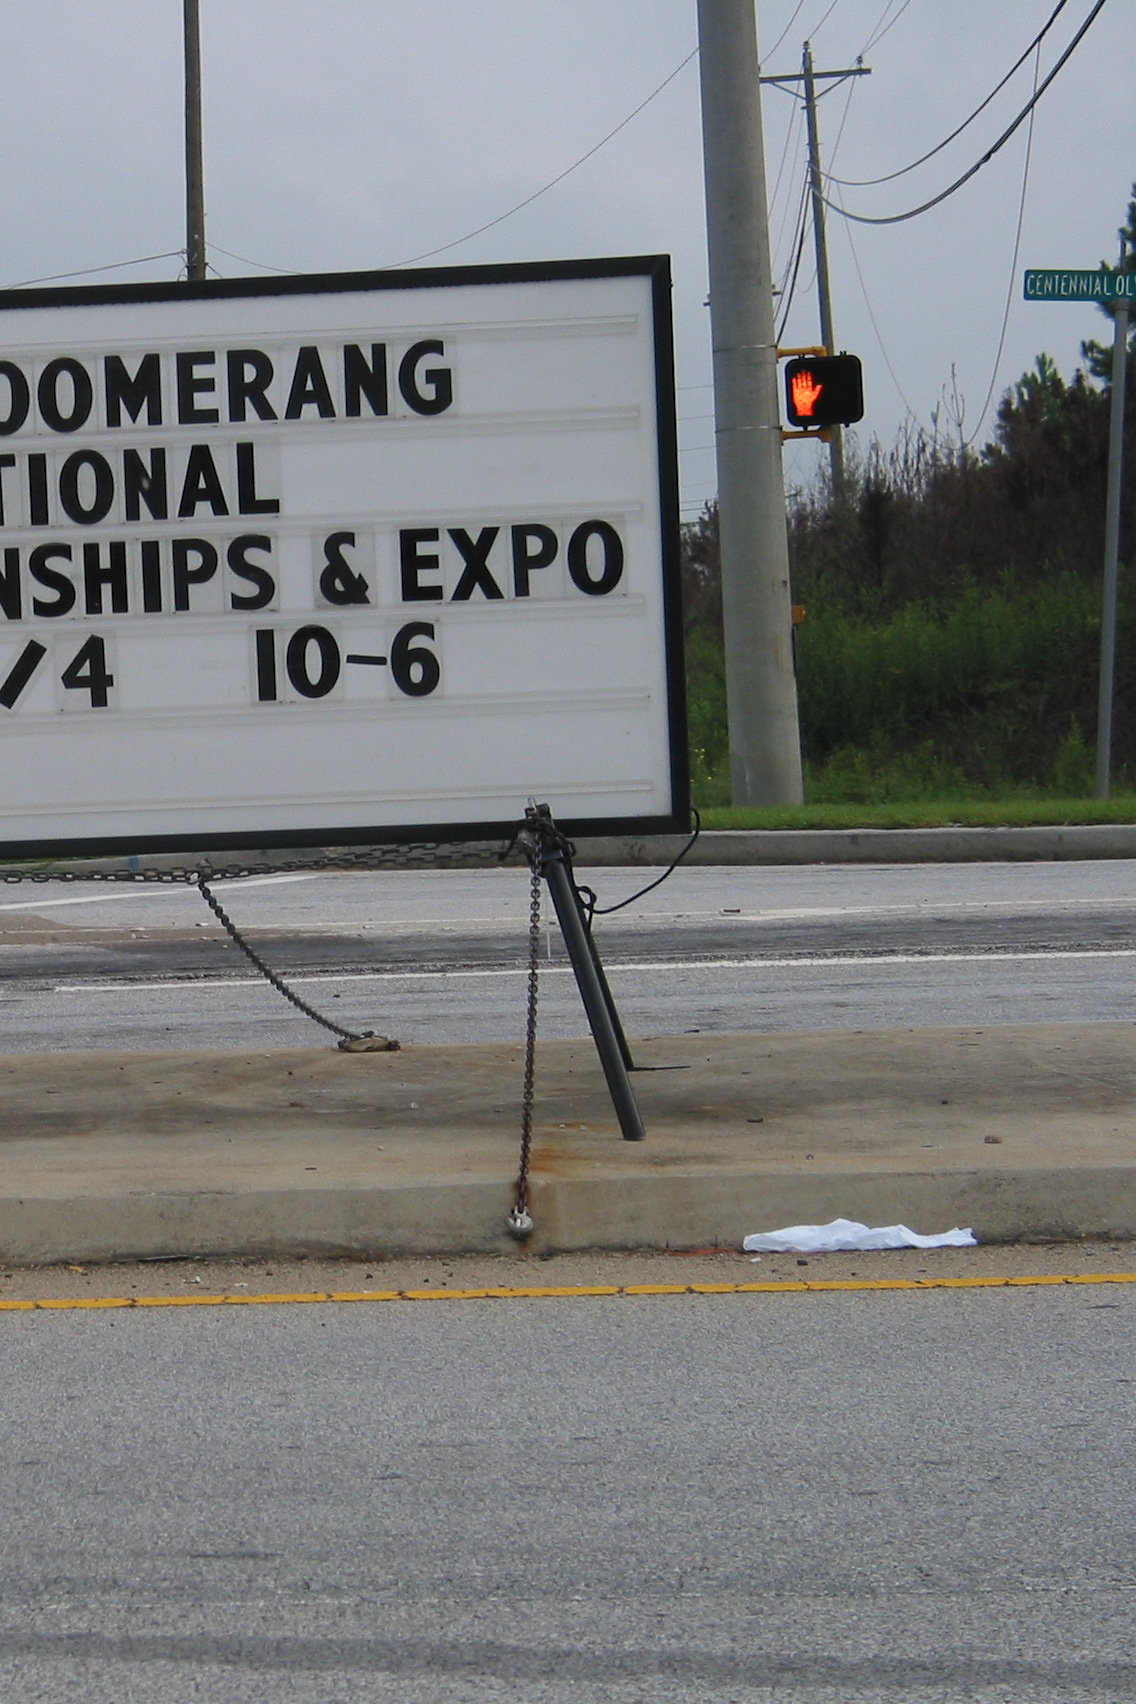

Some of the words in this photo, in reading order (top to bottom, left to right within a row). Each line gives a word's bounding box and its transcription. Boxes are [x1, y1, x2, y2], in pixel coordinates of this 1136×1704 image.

[1026, 274, 1112, 296] CENTENNIAL
[1115, 275, 1136, 296] OL
[320, 530, 371, 607] &
[399, 519, 625, 603] EXPO
[255, 620, 441, 703] 10-6
